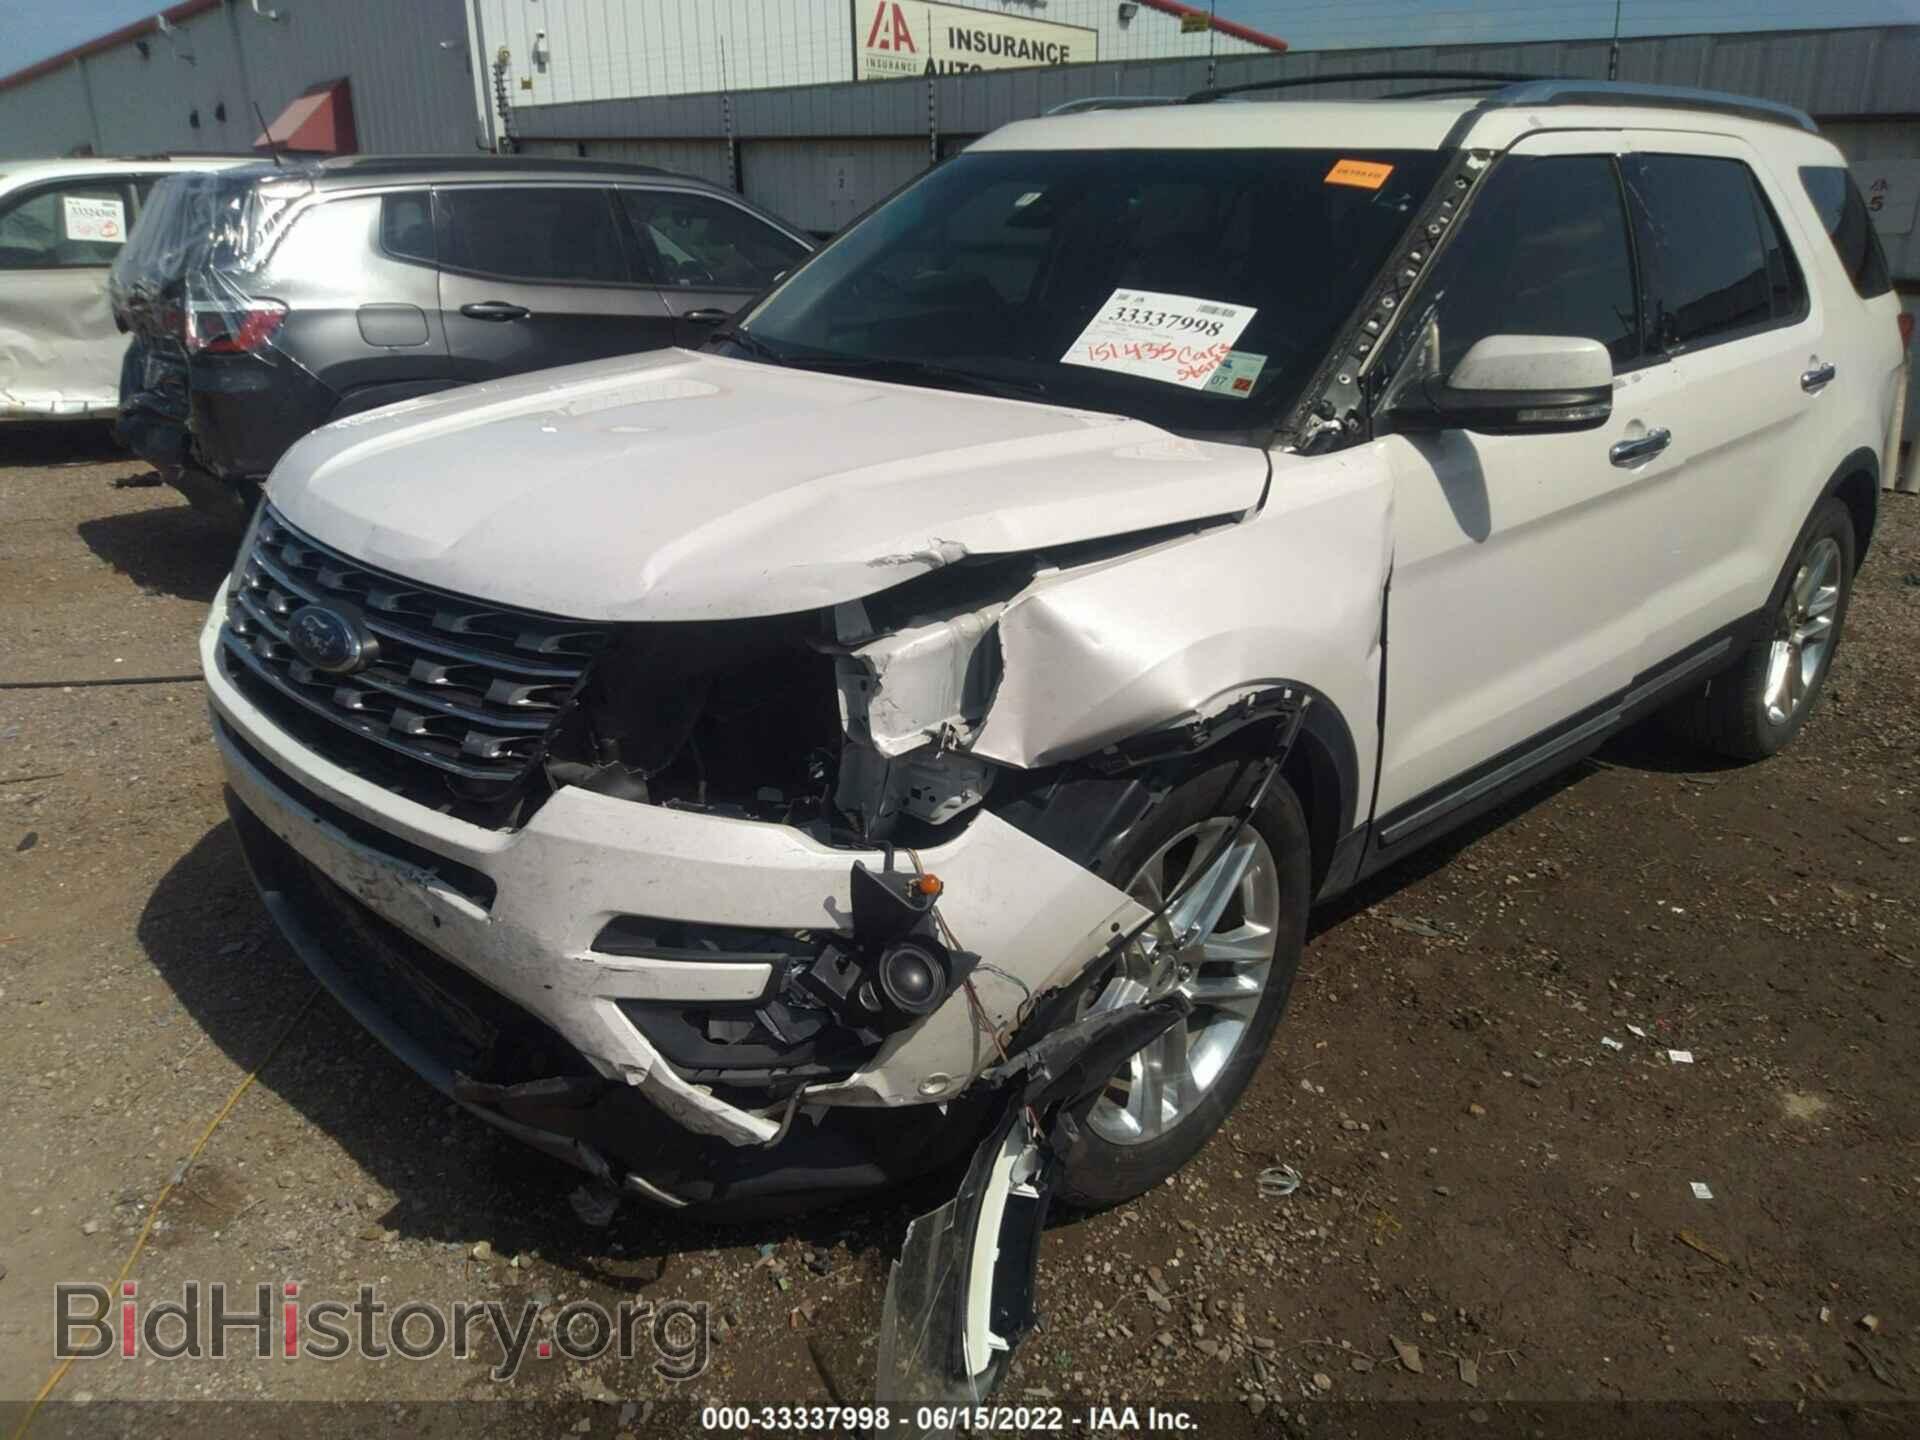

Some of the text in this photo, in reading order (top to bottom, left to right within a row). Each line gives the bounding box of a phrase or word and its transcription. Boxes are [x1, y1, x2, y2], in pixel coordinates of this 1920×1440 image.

[949, 27, 1070, 64] INSURANCE
[865, 56, 917, 72] INSURANCE
[1109, 306, 1224, 337] 33337998
